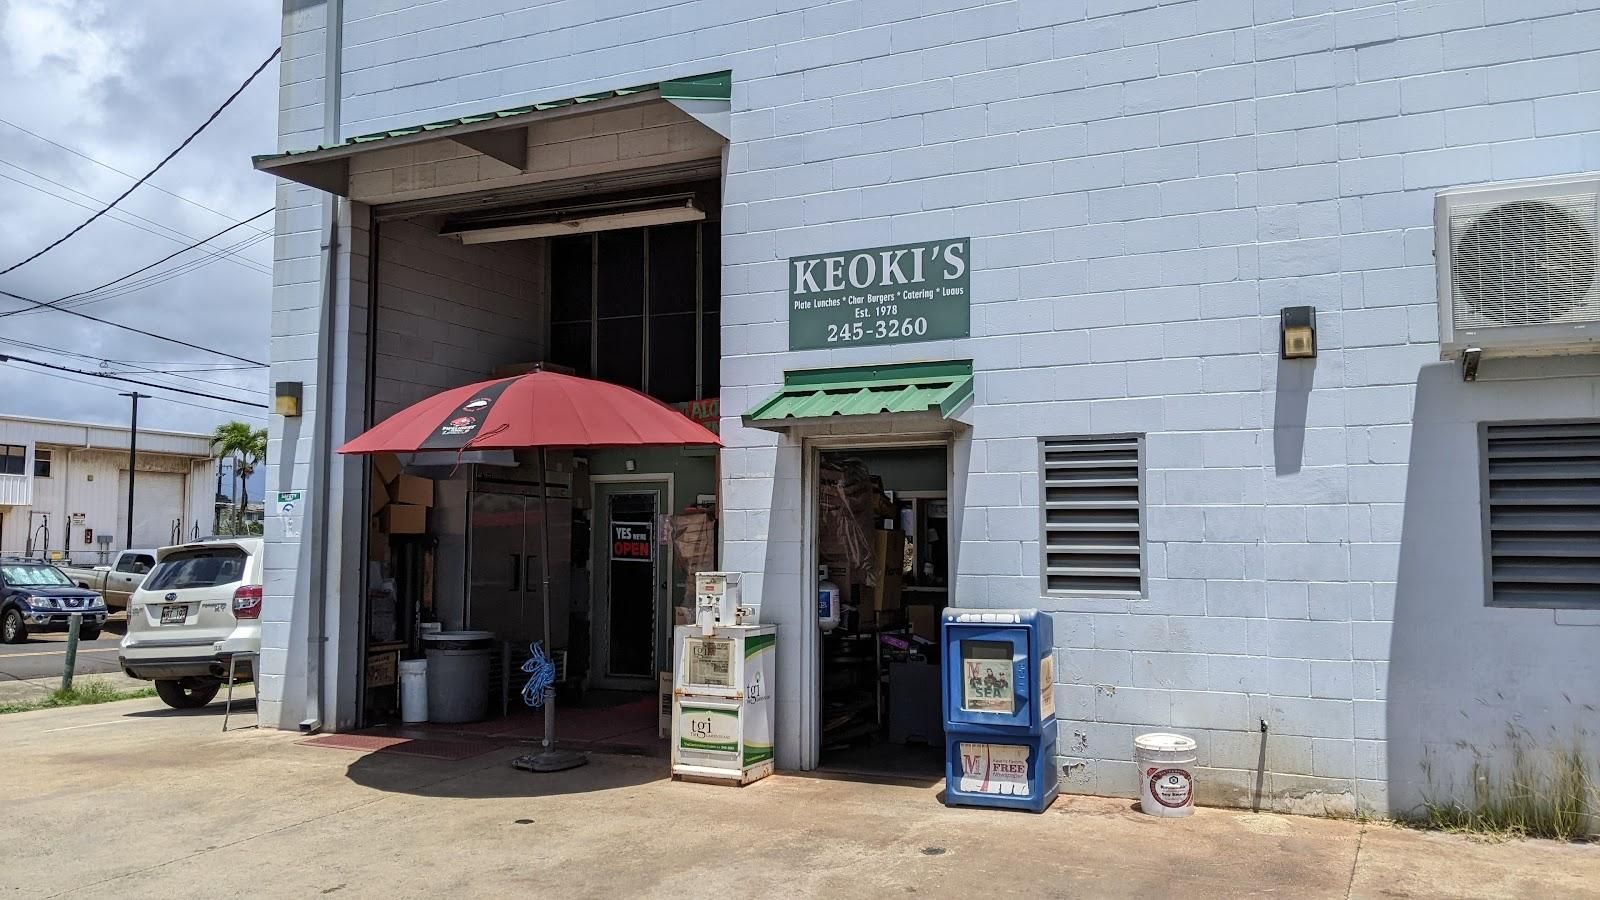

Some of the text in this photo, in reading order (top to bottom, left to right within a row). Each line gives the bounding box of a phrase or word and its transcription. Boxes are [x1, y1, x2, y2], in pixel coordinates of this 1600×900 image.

[793, 242, 965, 295] KEOKI'S
[794, 287, 964, 310] Plate Lunches Char Burgers Catering Luaus
[855, 304, 898, 318] Est. 1978
[827, 317, 928, 342] 245-3260
[615, 527, 632, 540] YES
[614, 541, 649, 557] OPEN
[747, 679, 761, 704] tgi
[975, 688, 1002, 698] SEA
[690, 717, 711, 738] tgi
[993, 763, 1025, 773] FREE
